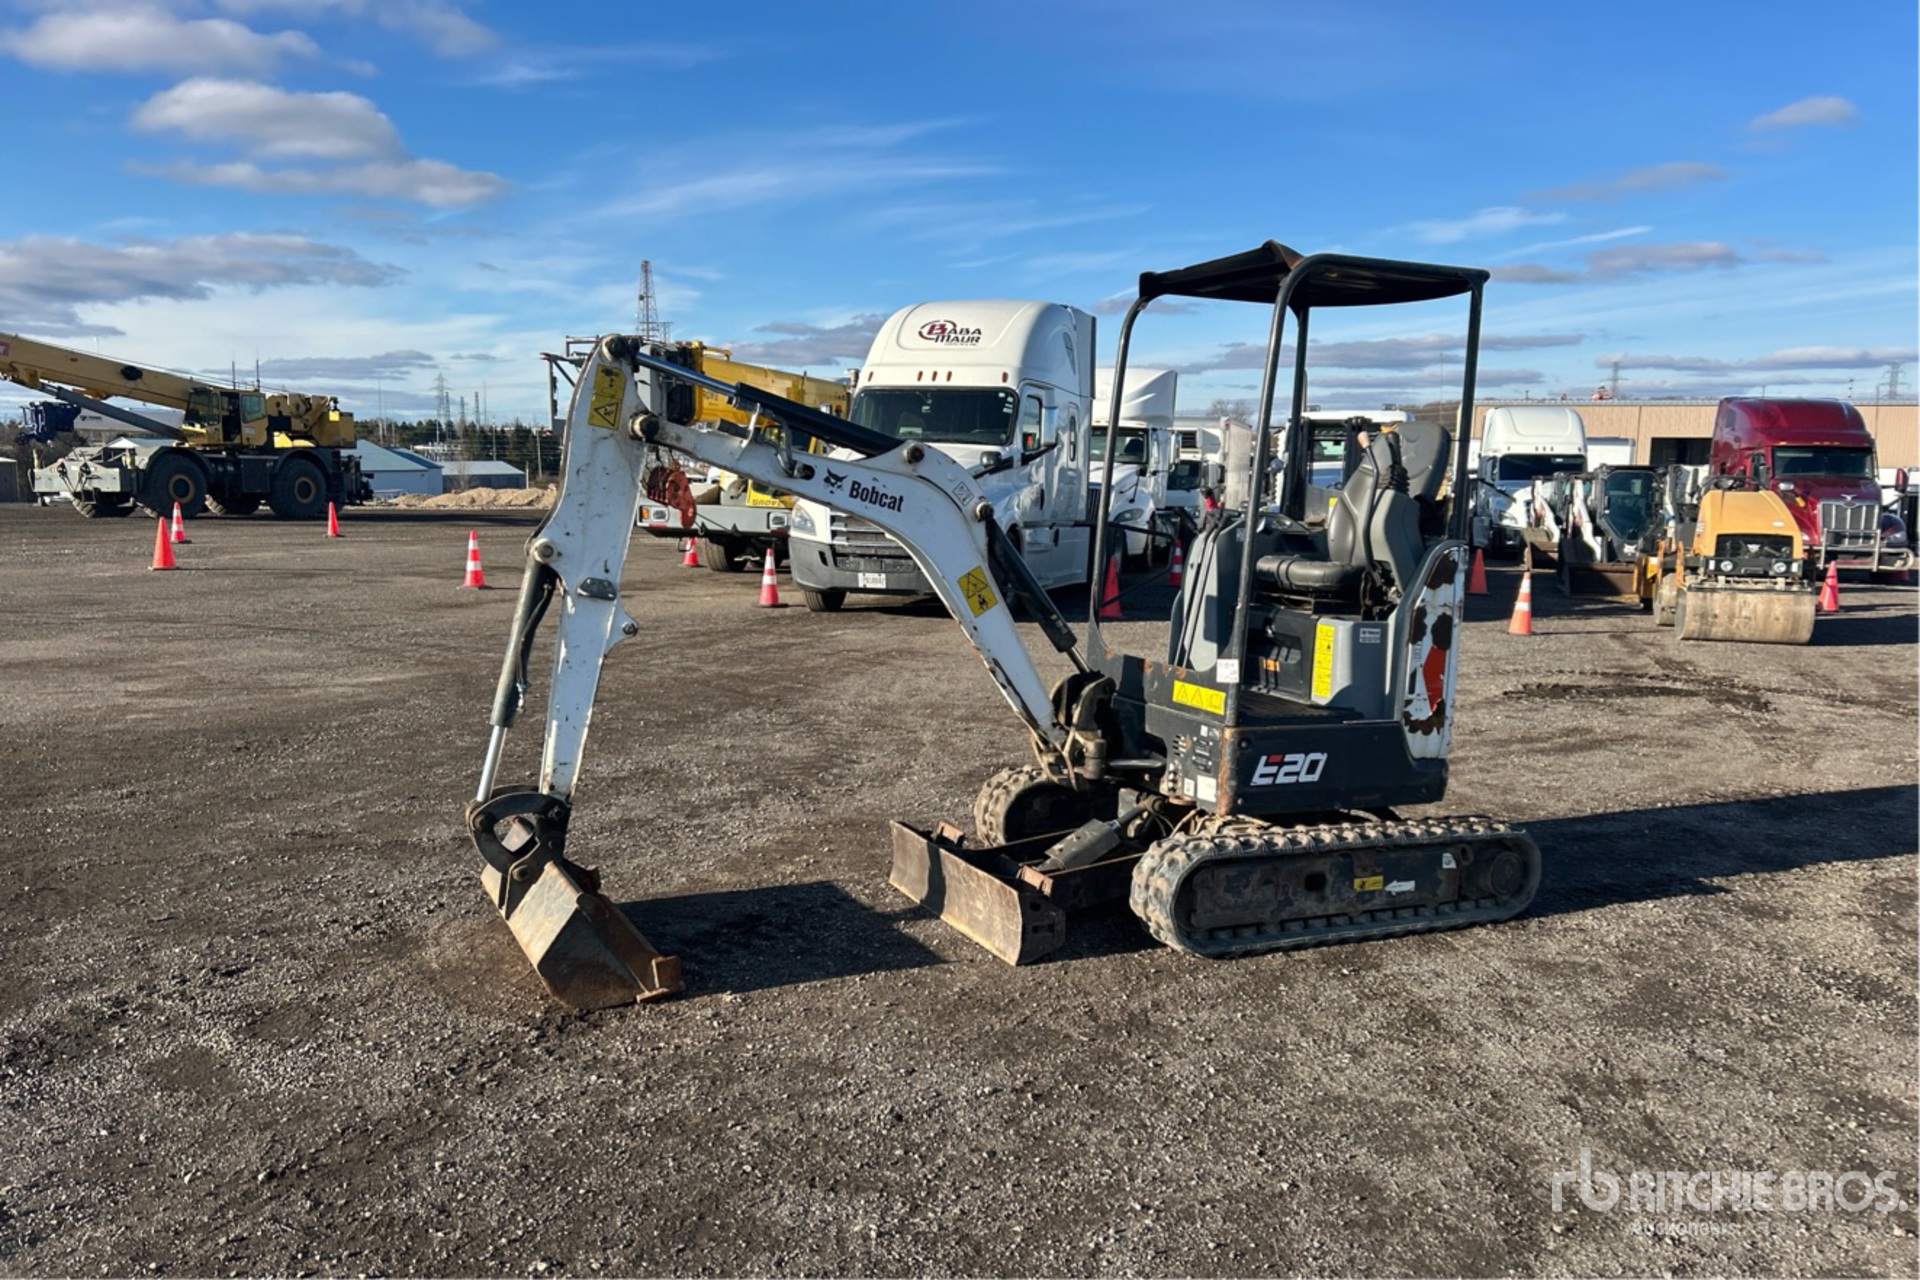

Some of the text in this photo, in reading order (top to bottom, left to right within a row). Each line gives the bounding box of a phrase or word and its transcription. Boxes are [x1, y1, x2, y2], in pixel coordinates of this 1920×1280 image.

[927, 323, 982, 336] BABA
[934, 335, 982, 343] MAUR
[848, 480, 904, 513] Bobcat
[1250, 752, 1328, 786] E20
